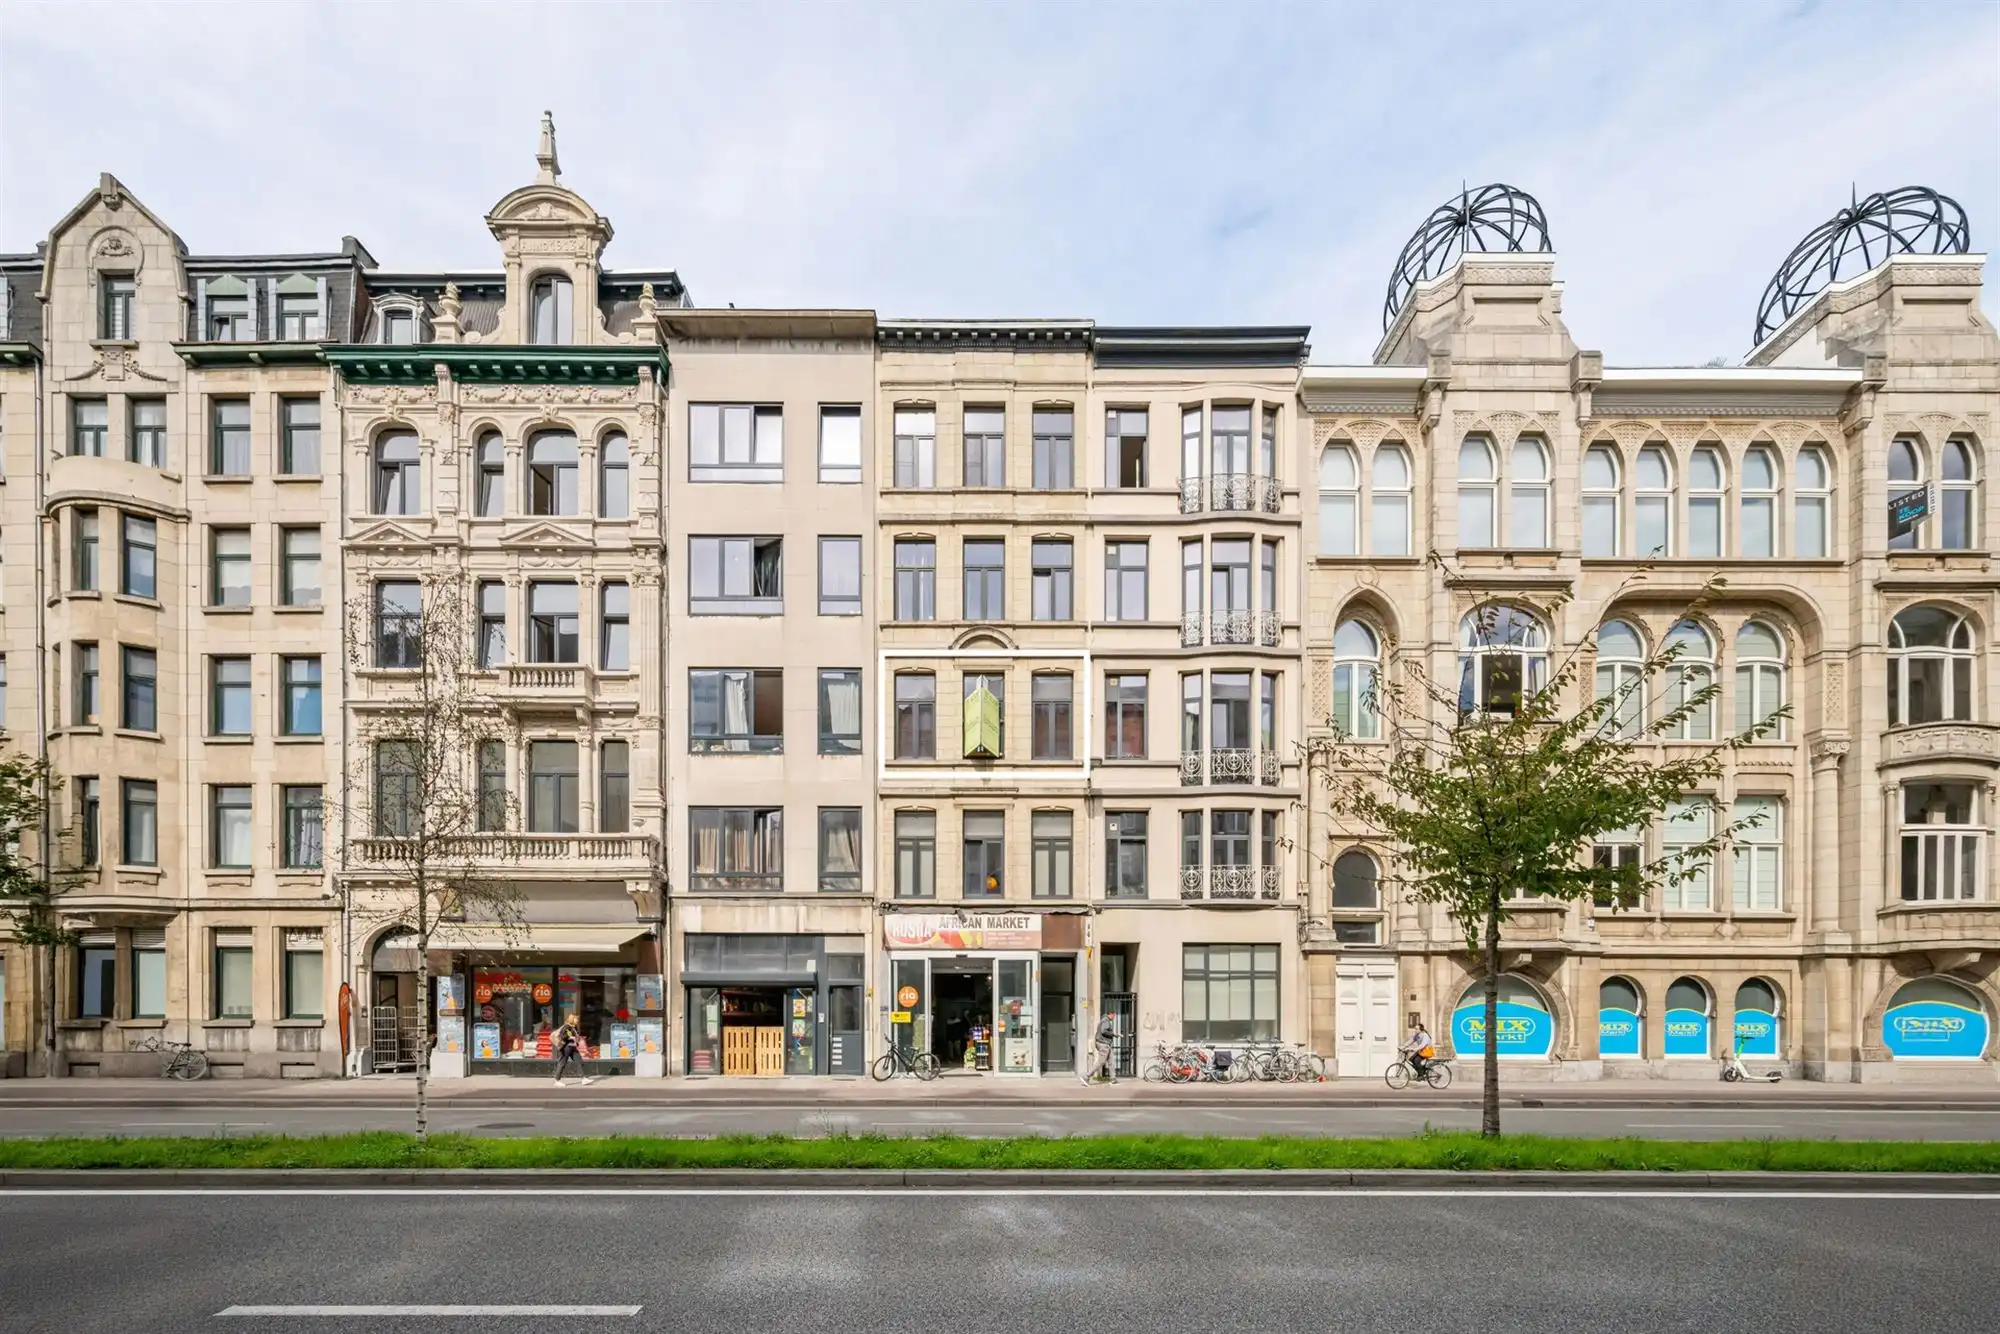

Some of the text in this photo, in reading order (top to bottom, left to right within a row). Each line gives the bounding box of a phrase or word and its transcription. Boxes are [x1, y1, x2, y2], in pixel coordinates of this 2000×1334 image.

[1888, 491, 1925, 510] LISTED
[987, 916, 1030, 929] MARKET
[475, 985, 491, 997] ria
[535, 986, 551, 997] ria
[900, 989, 916, 1000] ria
[1468, 1019, 1530, 1031] MIX
